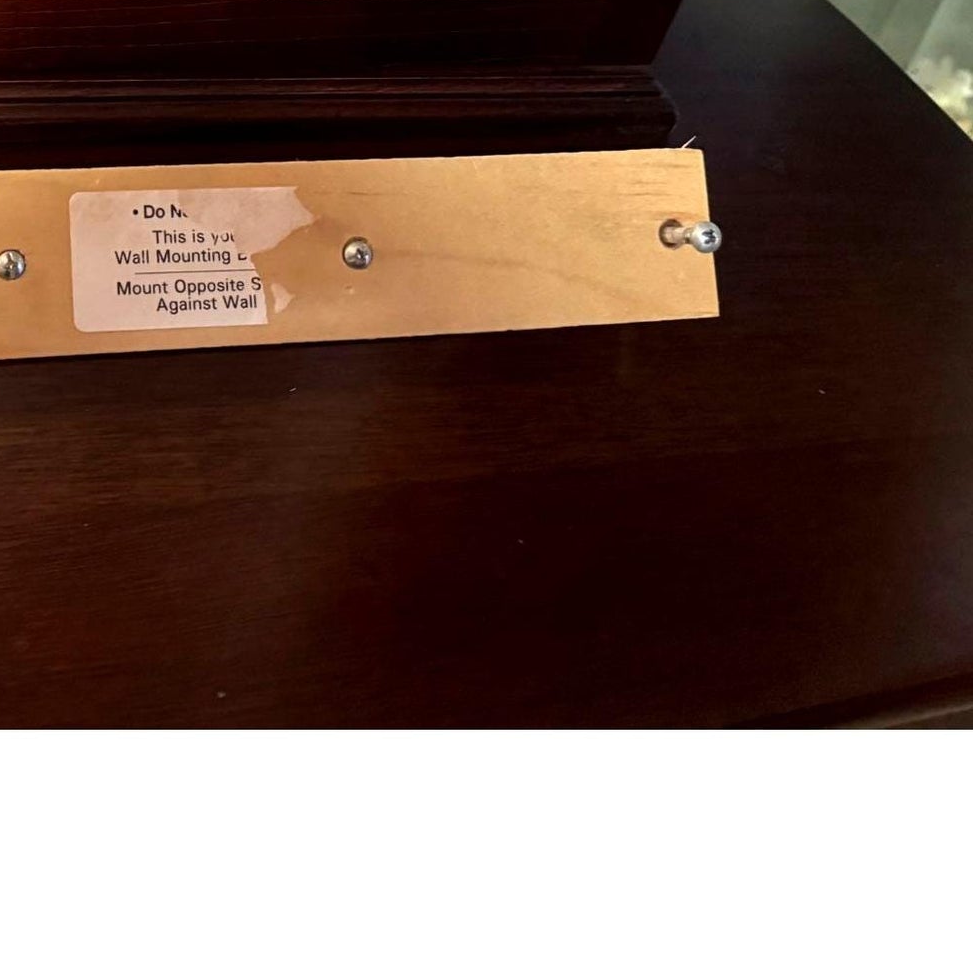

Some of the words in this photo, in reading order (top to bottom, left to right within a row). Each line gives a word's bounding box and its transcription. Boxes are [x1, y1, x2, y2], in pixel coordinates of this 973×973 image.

[143, 204, 166, 219] Do
[151, 229, 187, 244] This
[191, 228, 205, 243] is
[114, 249, 149, 265] Wall
[156, 247, 231, 265] Mounting
[116, 280, 168, 296] Mount
[174, 277, 245, 296] Opposite
[156, 297, 217, 315] Against
[222, 294, 258, 309] Wall
